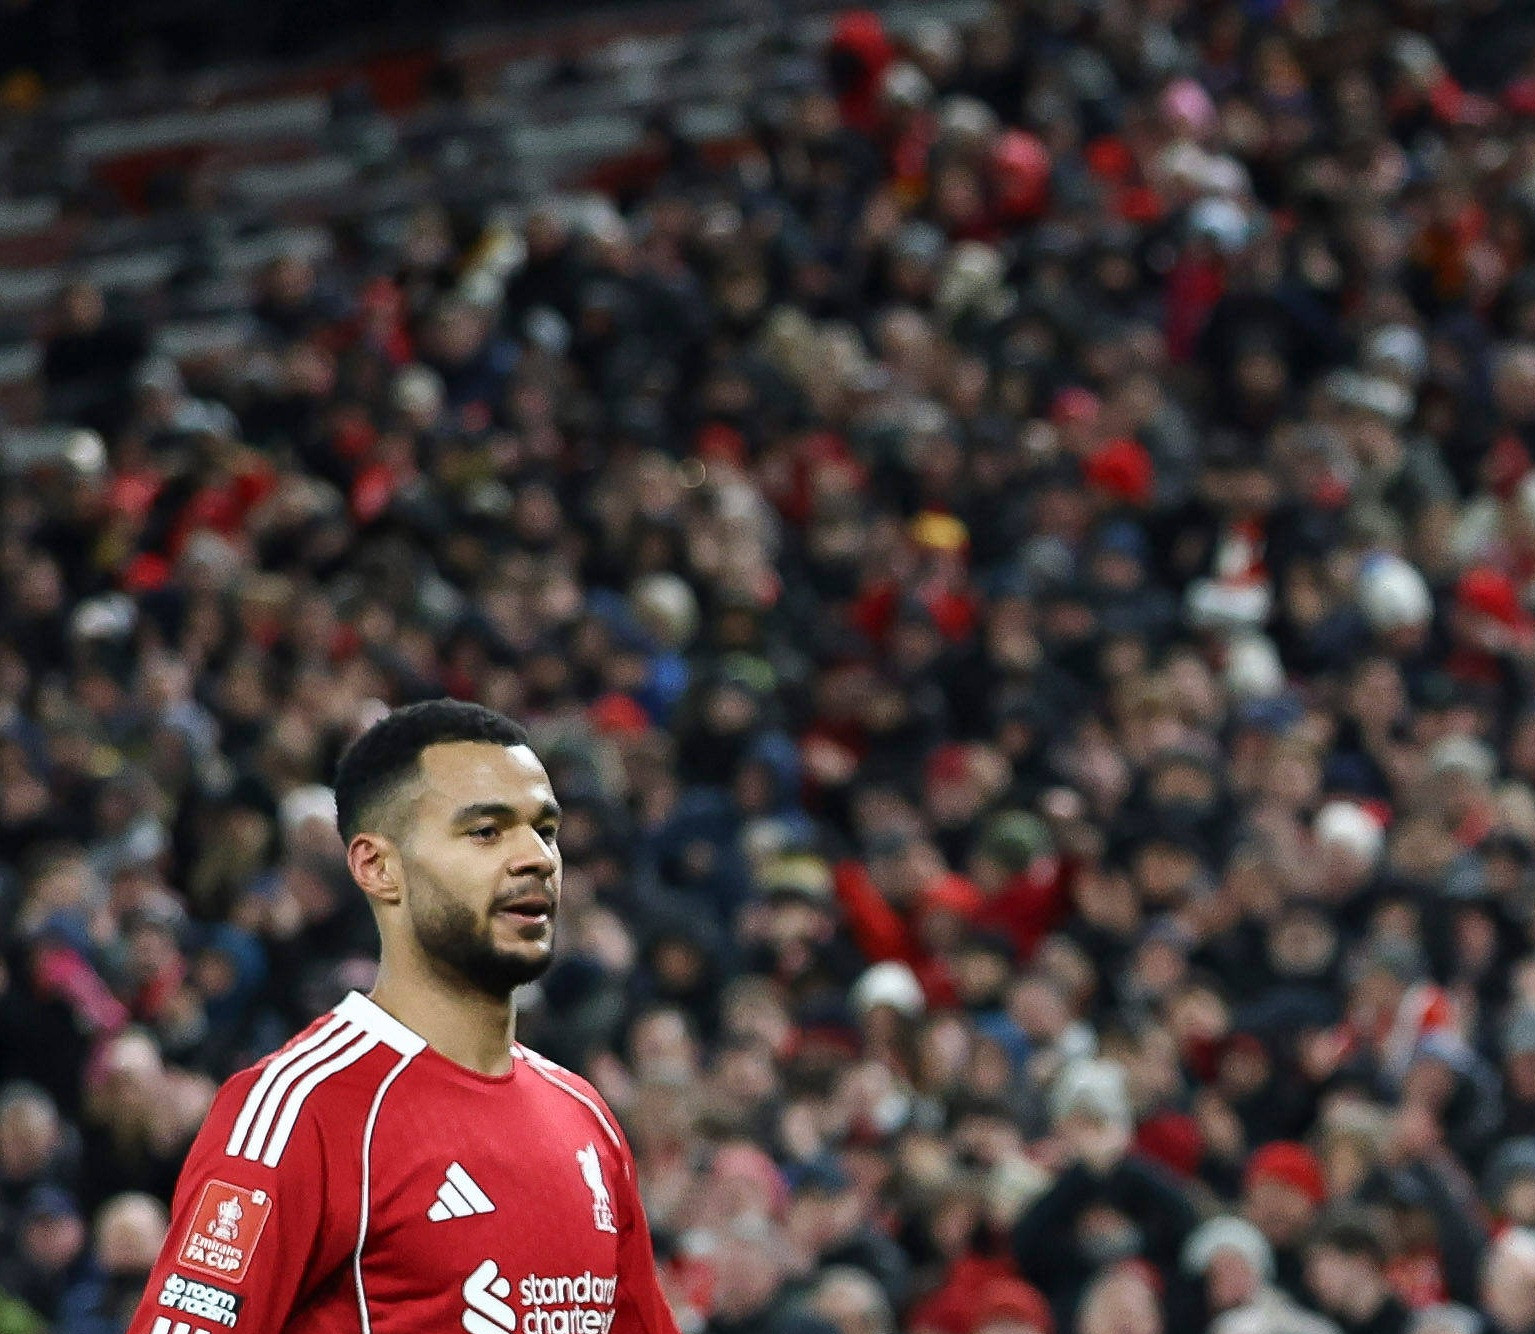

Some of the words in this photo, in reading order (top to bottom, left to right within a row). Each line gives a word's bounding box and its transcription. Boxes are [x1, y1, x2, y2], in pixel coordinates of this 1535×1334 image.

[186, 1244, 206, 1262] FA
[205, 1251, 241, 1272] CUP
[191, 1232, 243, 1260] Emirates
[158, 1289, 182, 1307] or
[185, 1282, 236, 1311] room
